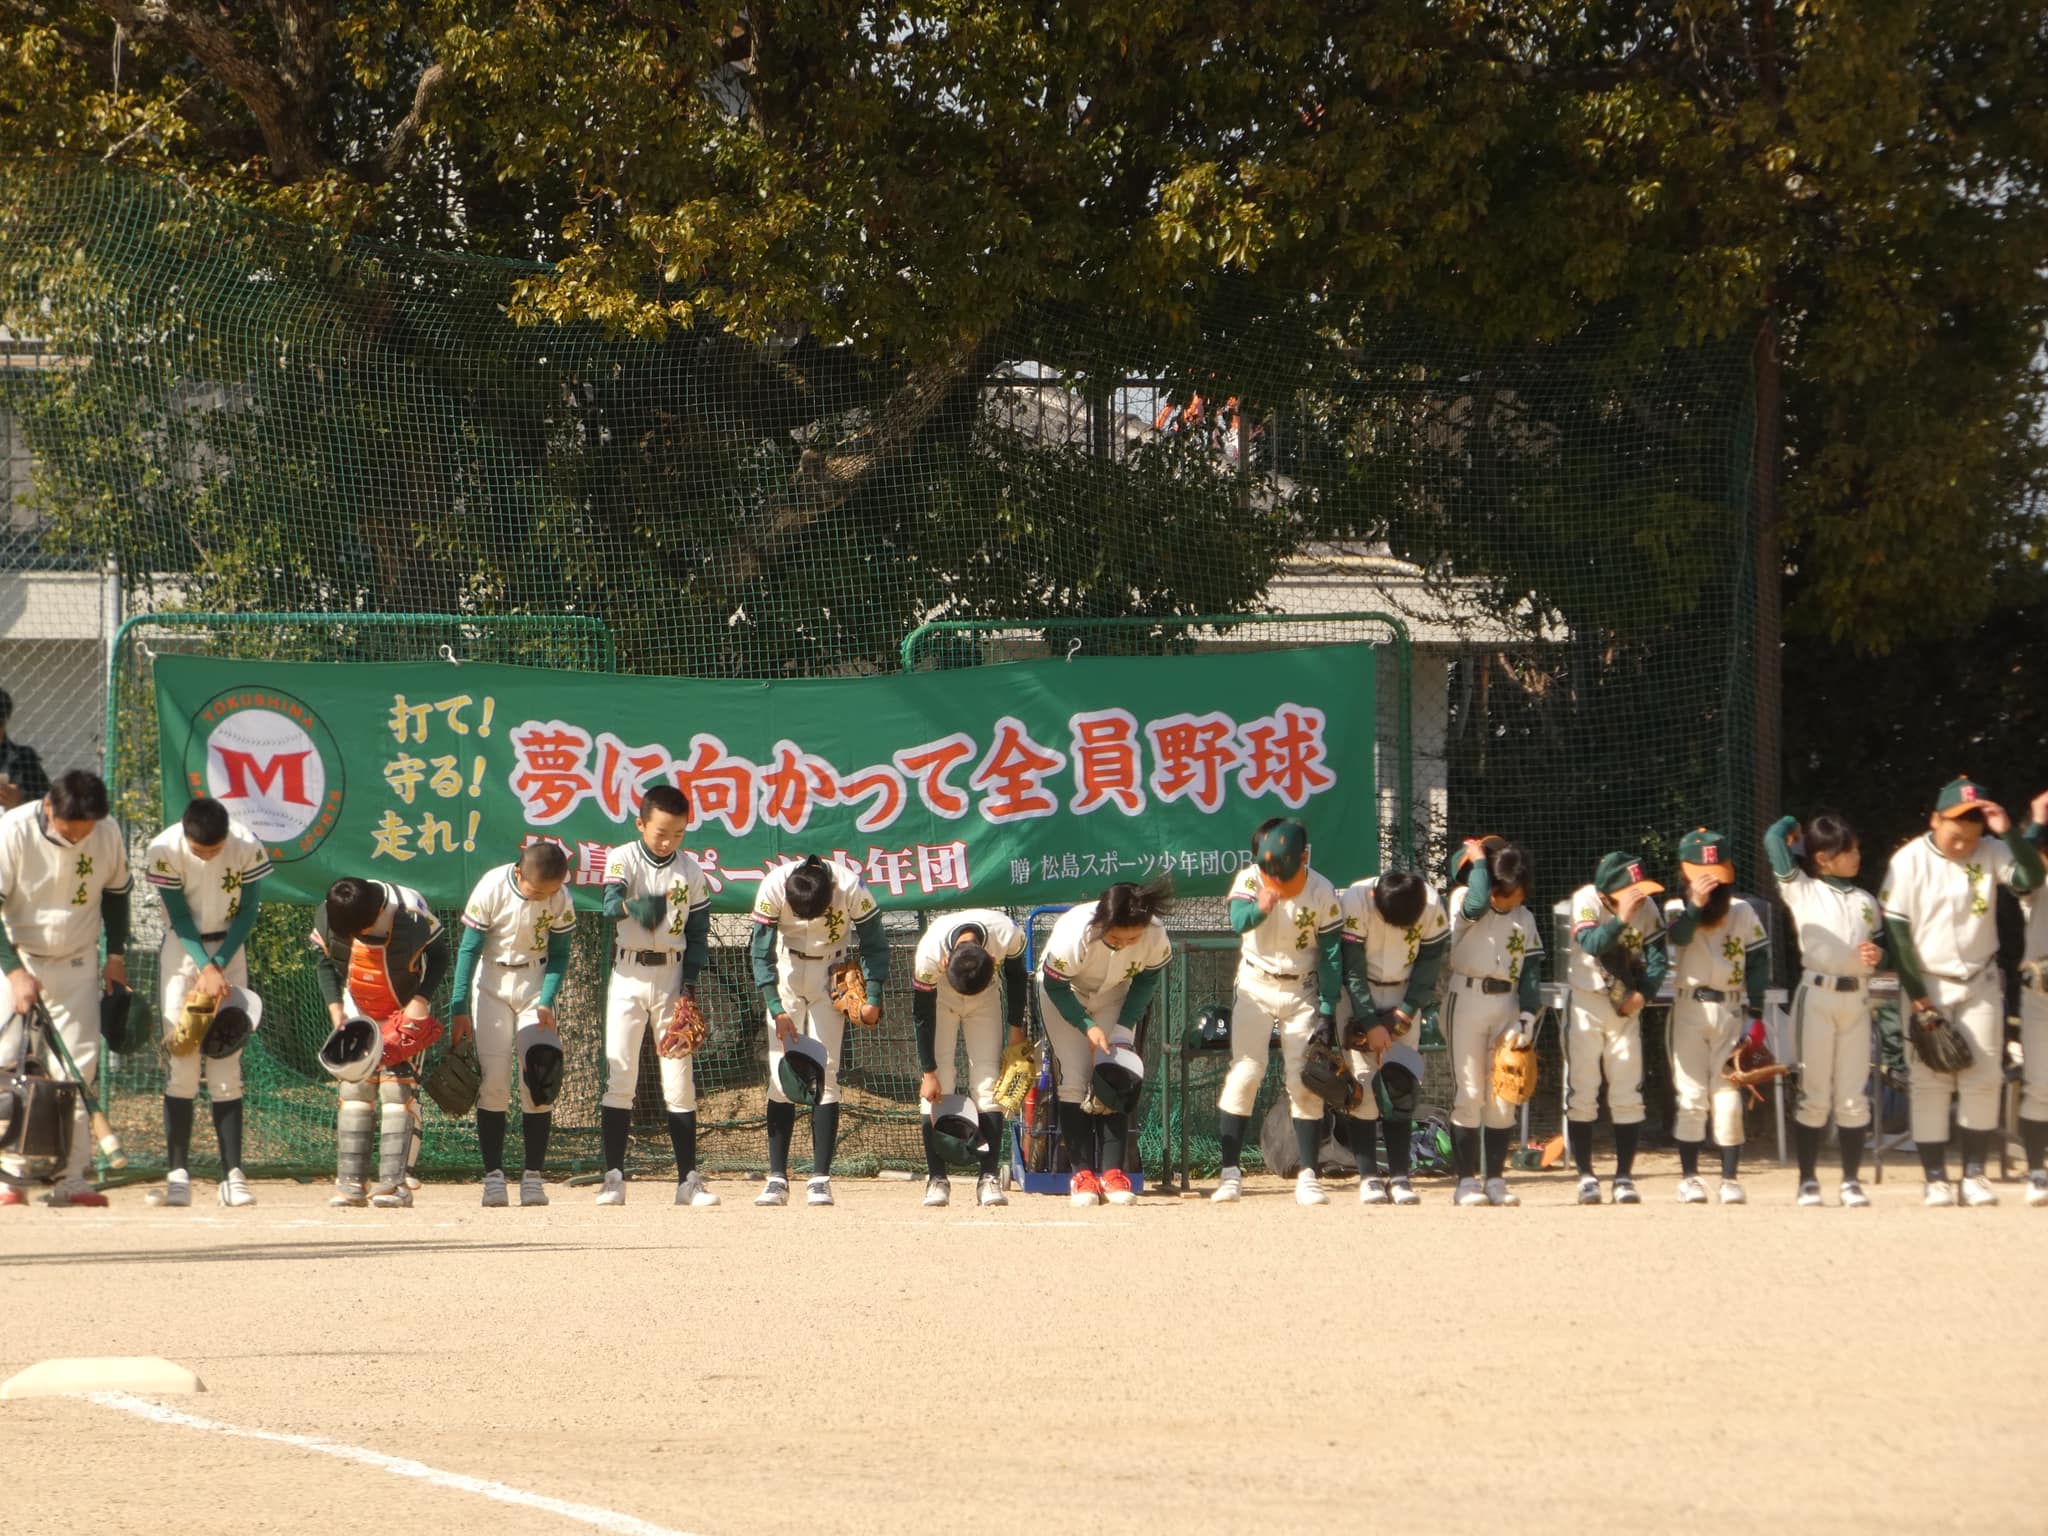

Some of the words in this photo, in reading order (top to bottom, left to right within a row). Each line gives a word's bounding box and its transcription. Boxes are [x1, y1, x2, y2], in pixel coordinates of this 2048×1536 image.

[388, 694, 495, 743] 打て!
[209, 743, 318, 808] M
[383, 752, 486, 804] 守る!
[510, 702, 1337, 837] 夢に向かって全員野球
[370, 810, 480, 861] 走れ!
